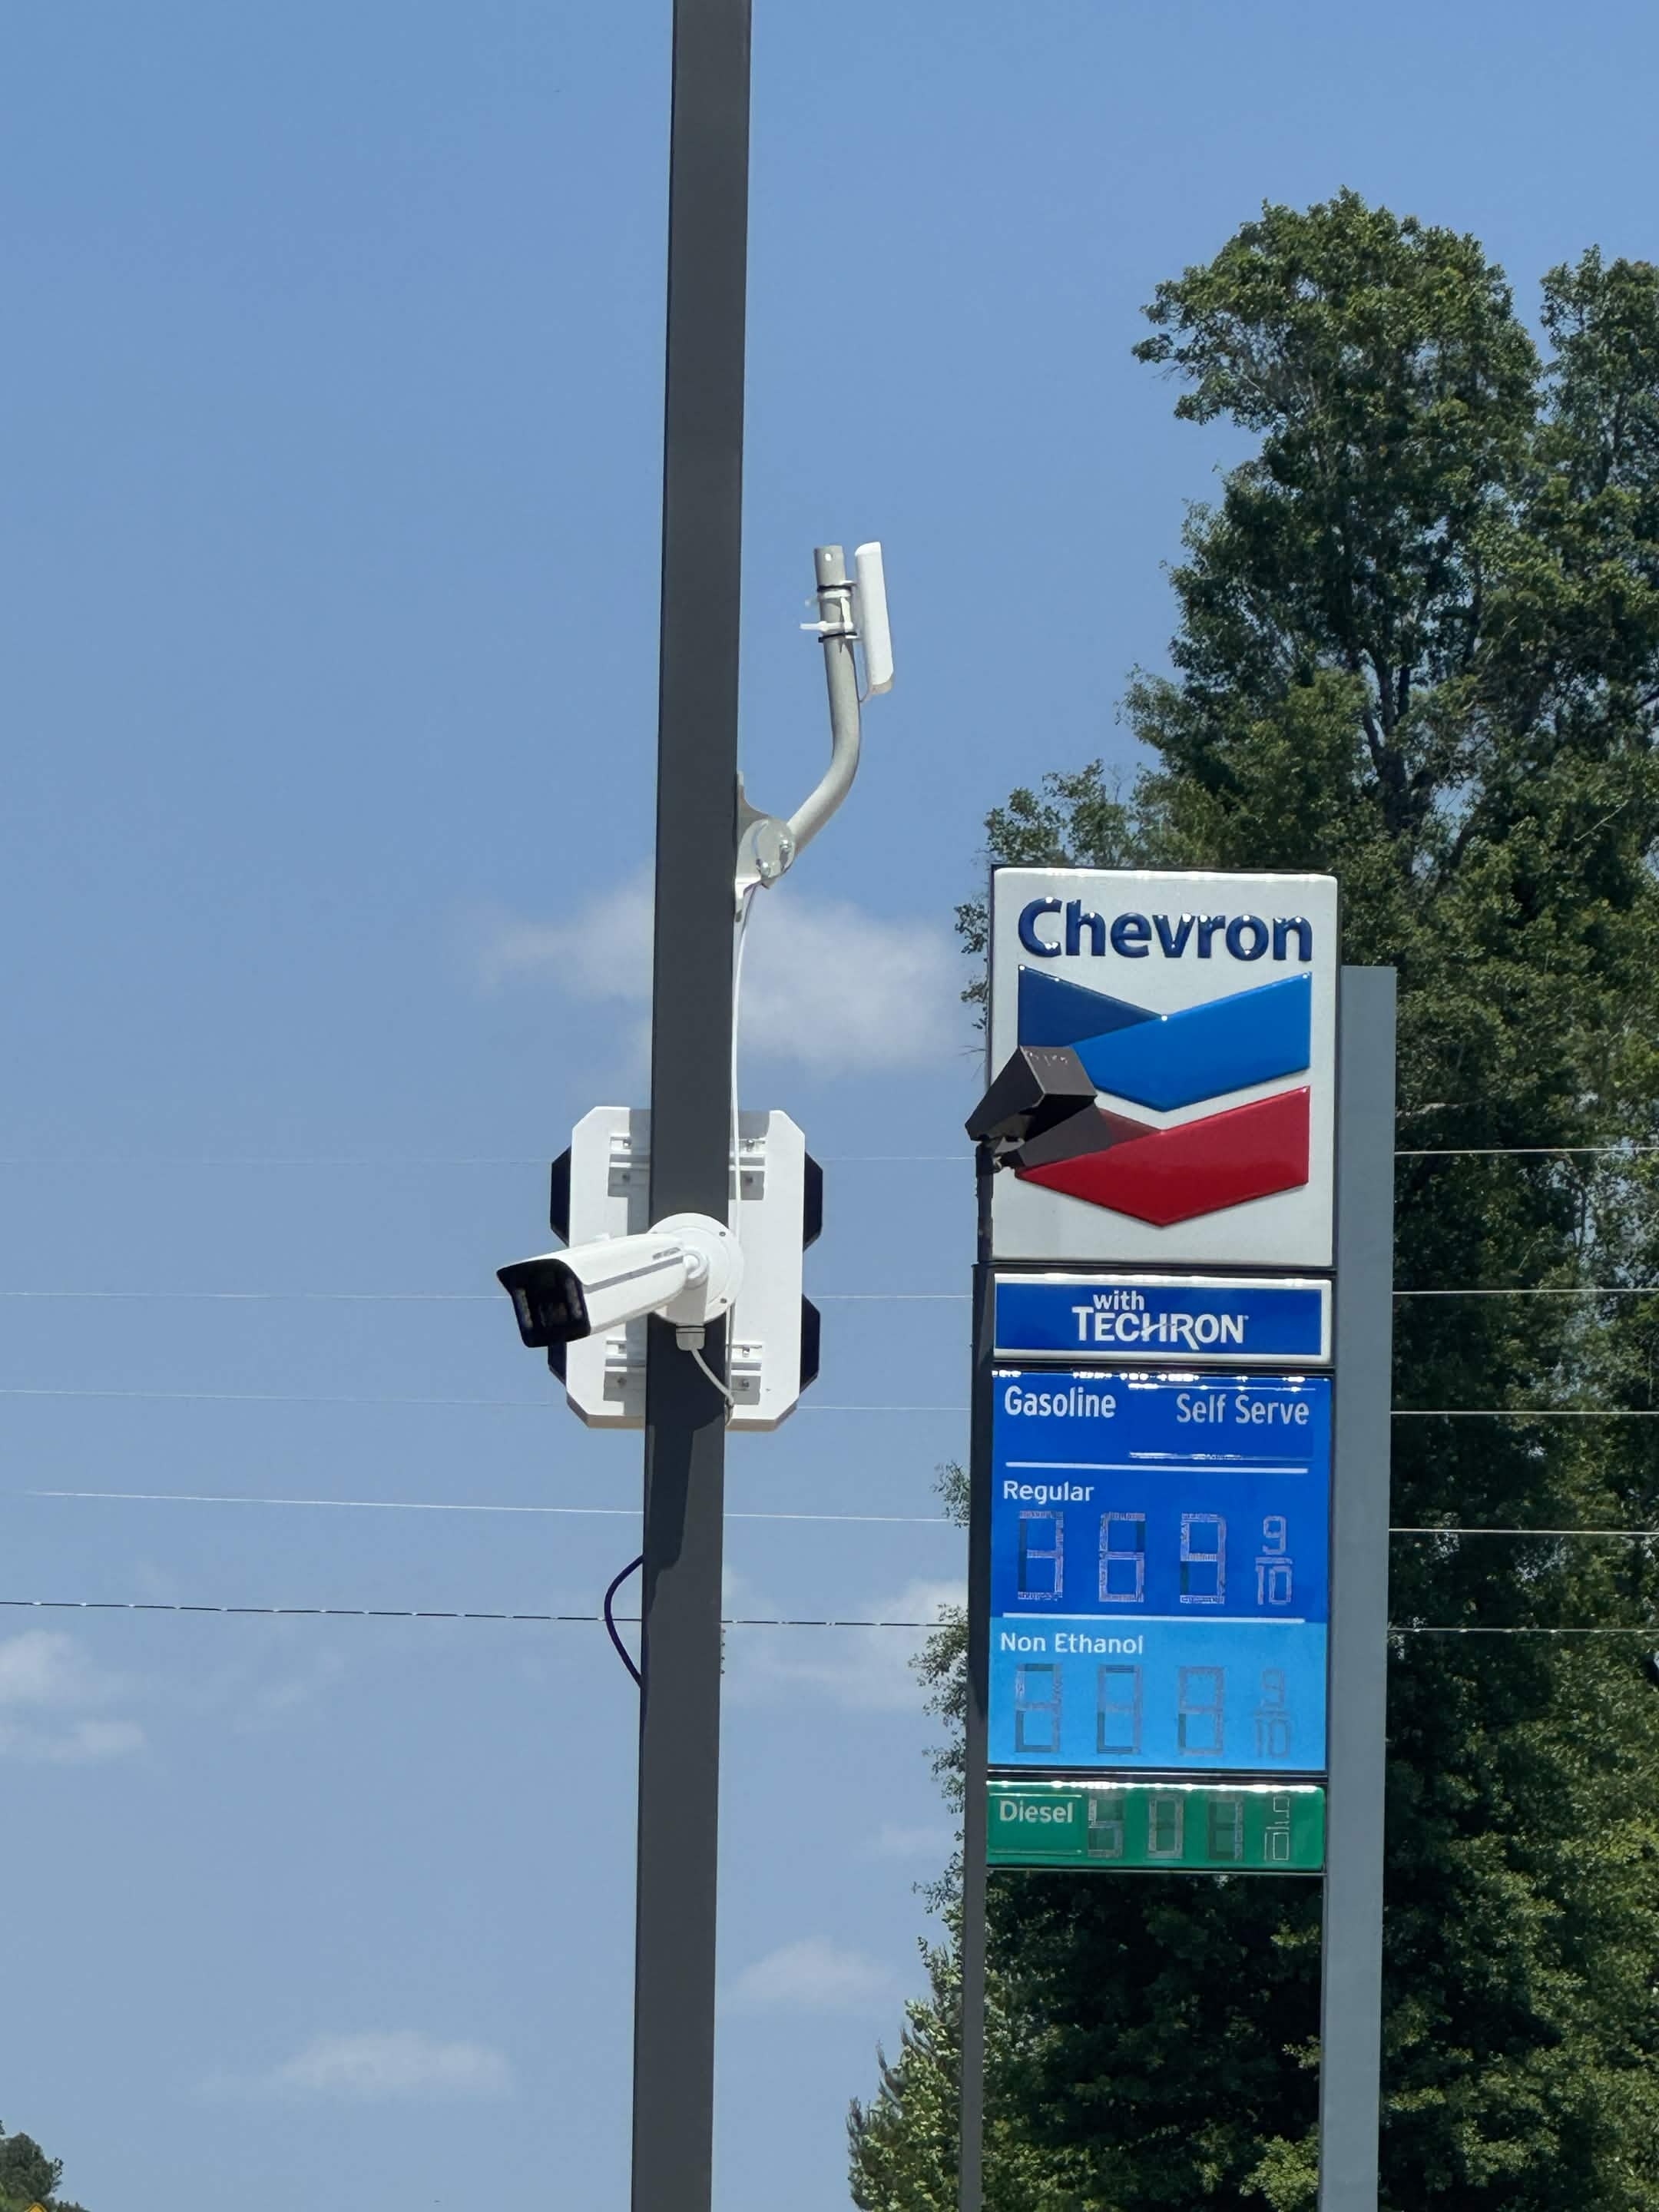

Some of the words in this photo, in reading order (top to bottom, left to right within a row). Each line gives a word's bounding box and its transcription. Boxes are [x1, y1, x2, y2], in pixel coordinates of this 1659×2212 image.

[1018, 897, 1313, 962] Chevron
[1093, 1290, 1144, 1310] with
[1071, 1306, 1244, 1350] TECHRON
[1005, 1385, 1117, 1418] Gasoline
[1176, 1393, 1226, 1423] Self
[1235, 1394, 1310, 1425] Serve
[1003, 1481, 1094, 1505] Regular
[1001, 1633, 1045, 1652] Non
[1055, 1634, 1143, 1654] Ethanol
[1000, 1801, 1072, 1823] Diesel
